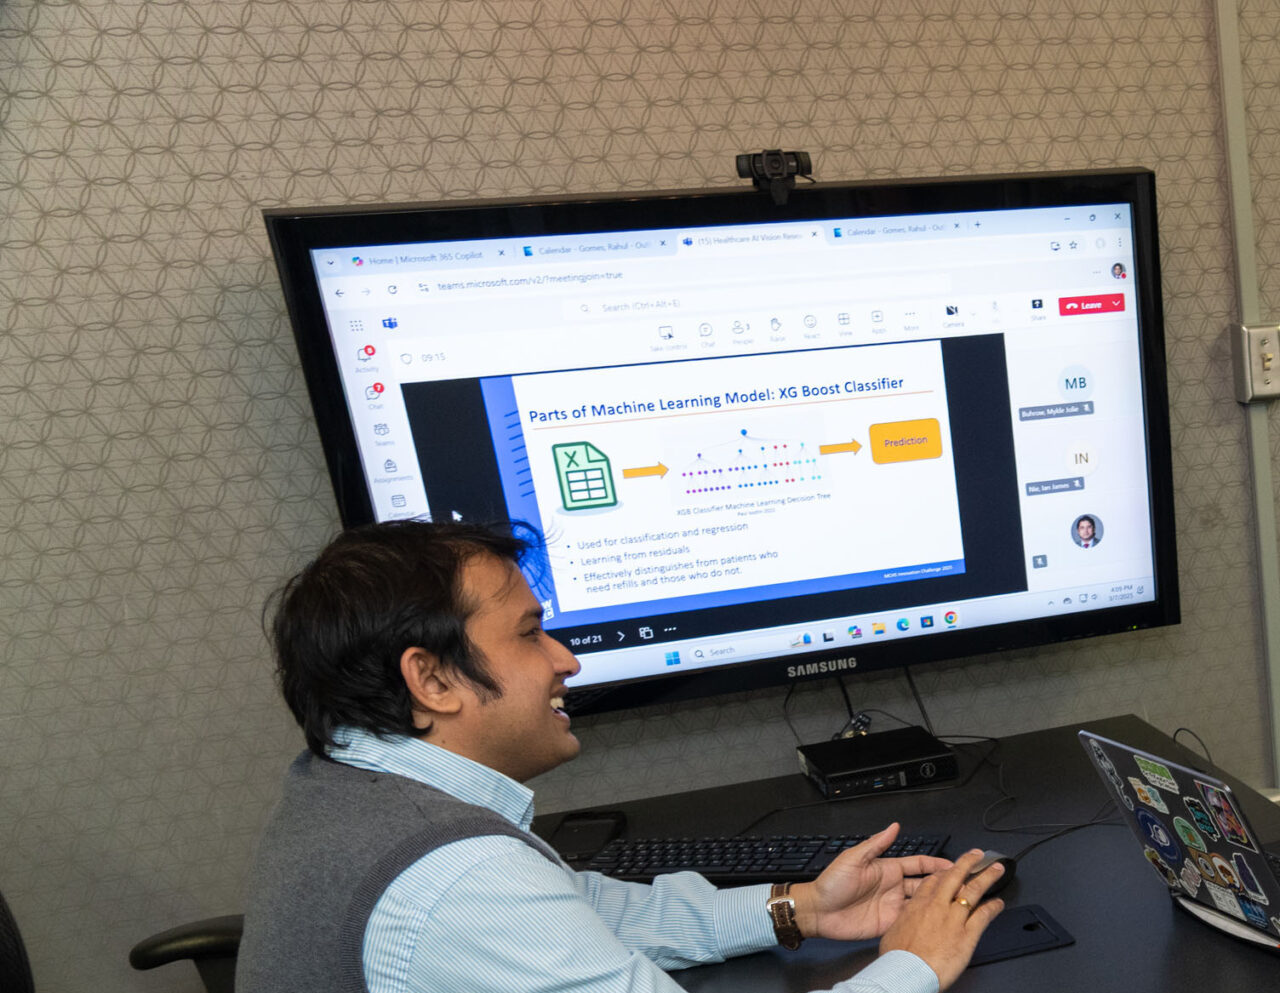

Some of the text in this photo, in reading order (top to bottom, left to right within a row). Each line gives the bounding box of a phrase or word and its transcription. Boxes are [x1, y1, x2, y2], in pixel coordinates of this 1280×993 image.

[714, 235, 749, 244] Healthcare
[400, 254, 437, 264] Microsoft
[439, 253, 453, 261] 365
[454, 252, 483, 262] Copilot
[602, 303, 630, 312] Search
[421, 353, 446, 362] 09:15
[1065, 377, 1086, 390] MB
[529, 378, 904, 422] Parts of Machine Learning Model: XG Boost Classifier
[884, 436, 928, 447] Prediction
[1075, 453, 1089, 464] IN
[726, 501, 755, 510] Machine
[757, 498, 786, 507] Learning
[787, 495, 815, 503] Decision
[577, 523, 748, 550] Used for classification and regression
[581, 546, 690, 566] Learning from residuals
[584, 551, 778, 583] Effectively distinguishes from patients who
[586, 566, 742, 593] need refills and those who do not.
[570, 634, 602, 646] 10 of 21
[710, 646, 735, 656] Search
[787, 657, 857, 677] SAMSUNG
